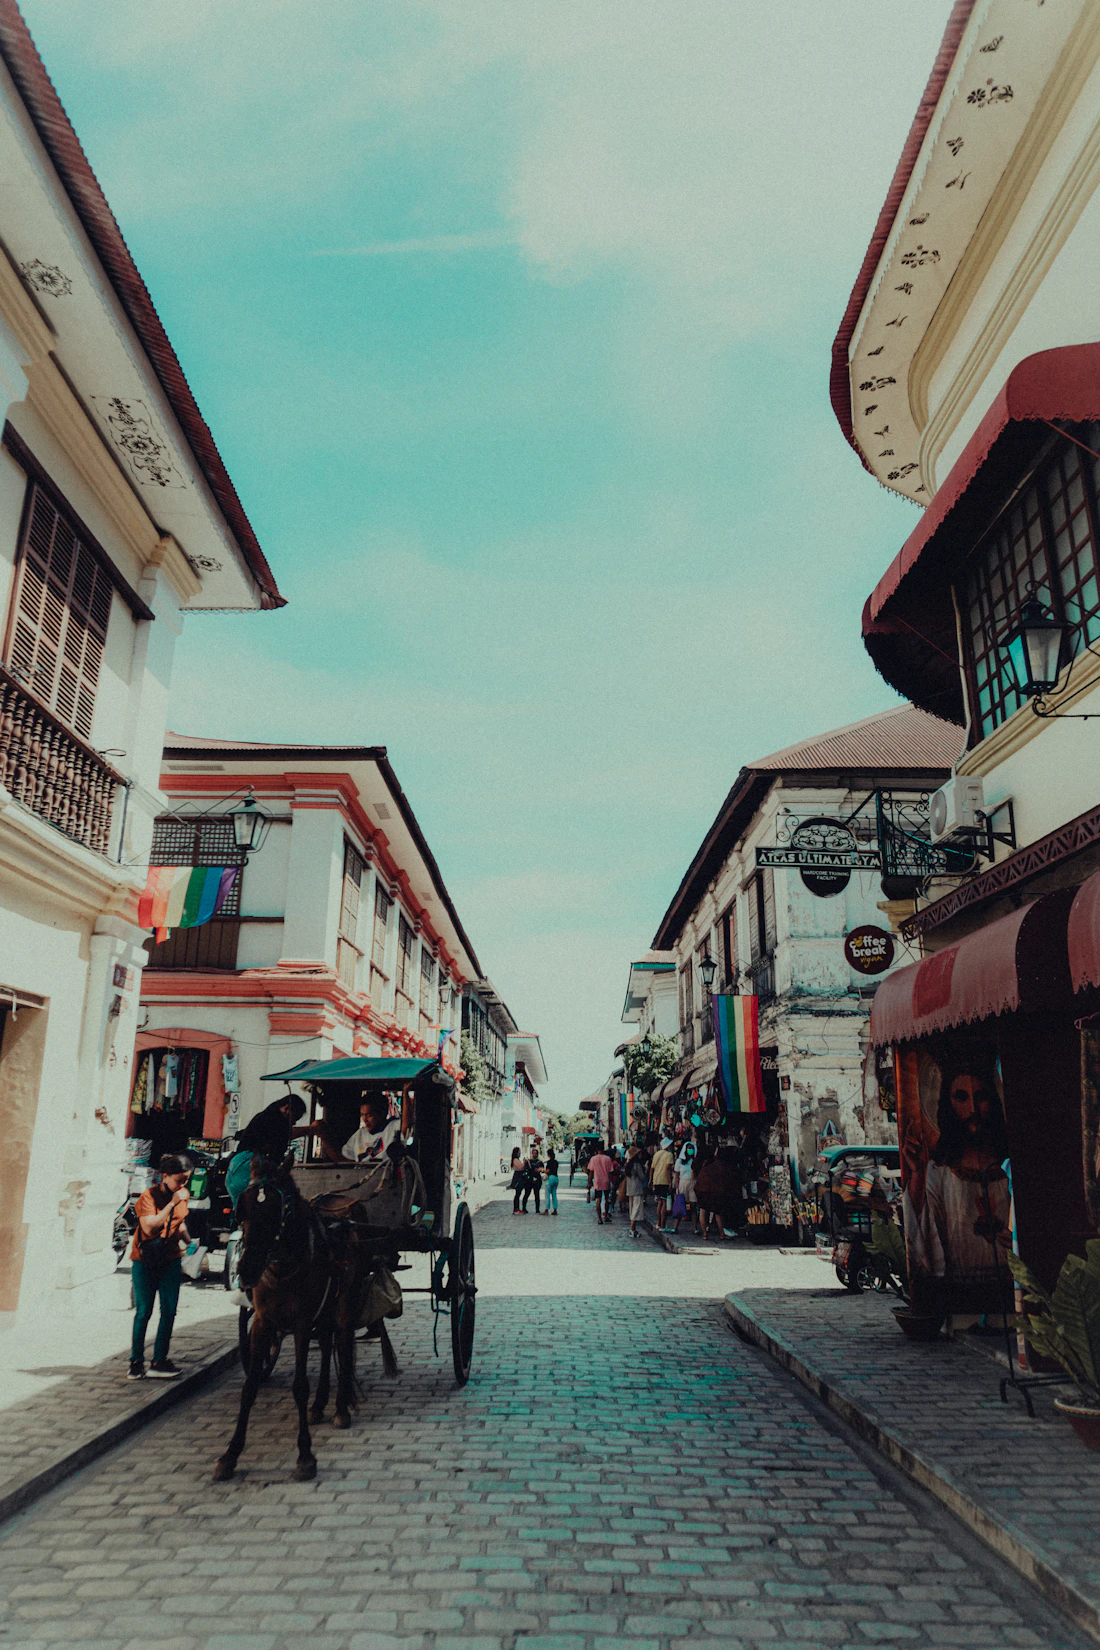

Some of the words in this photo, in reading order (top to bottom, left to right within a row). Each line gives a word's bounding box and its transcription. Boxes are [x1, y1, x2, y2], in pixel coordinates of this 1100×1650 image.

[759, 853, 795, 863] ATLAS
[798, 853, 851, 865] ULTIMATE
[849, 935, 887, 949] coffee
[852, 944, 887, 958] break
[860, 954, 883, 969] vigan
